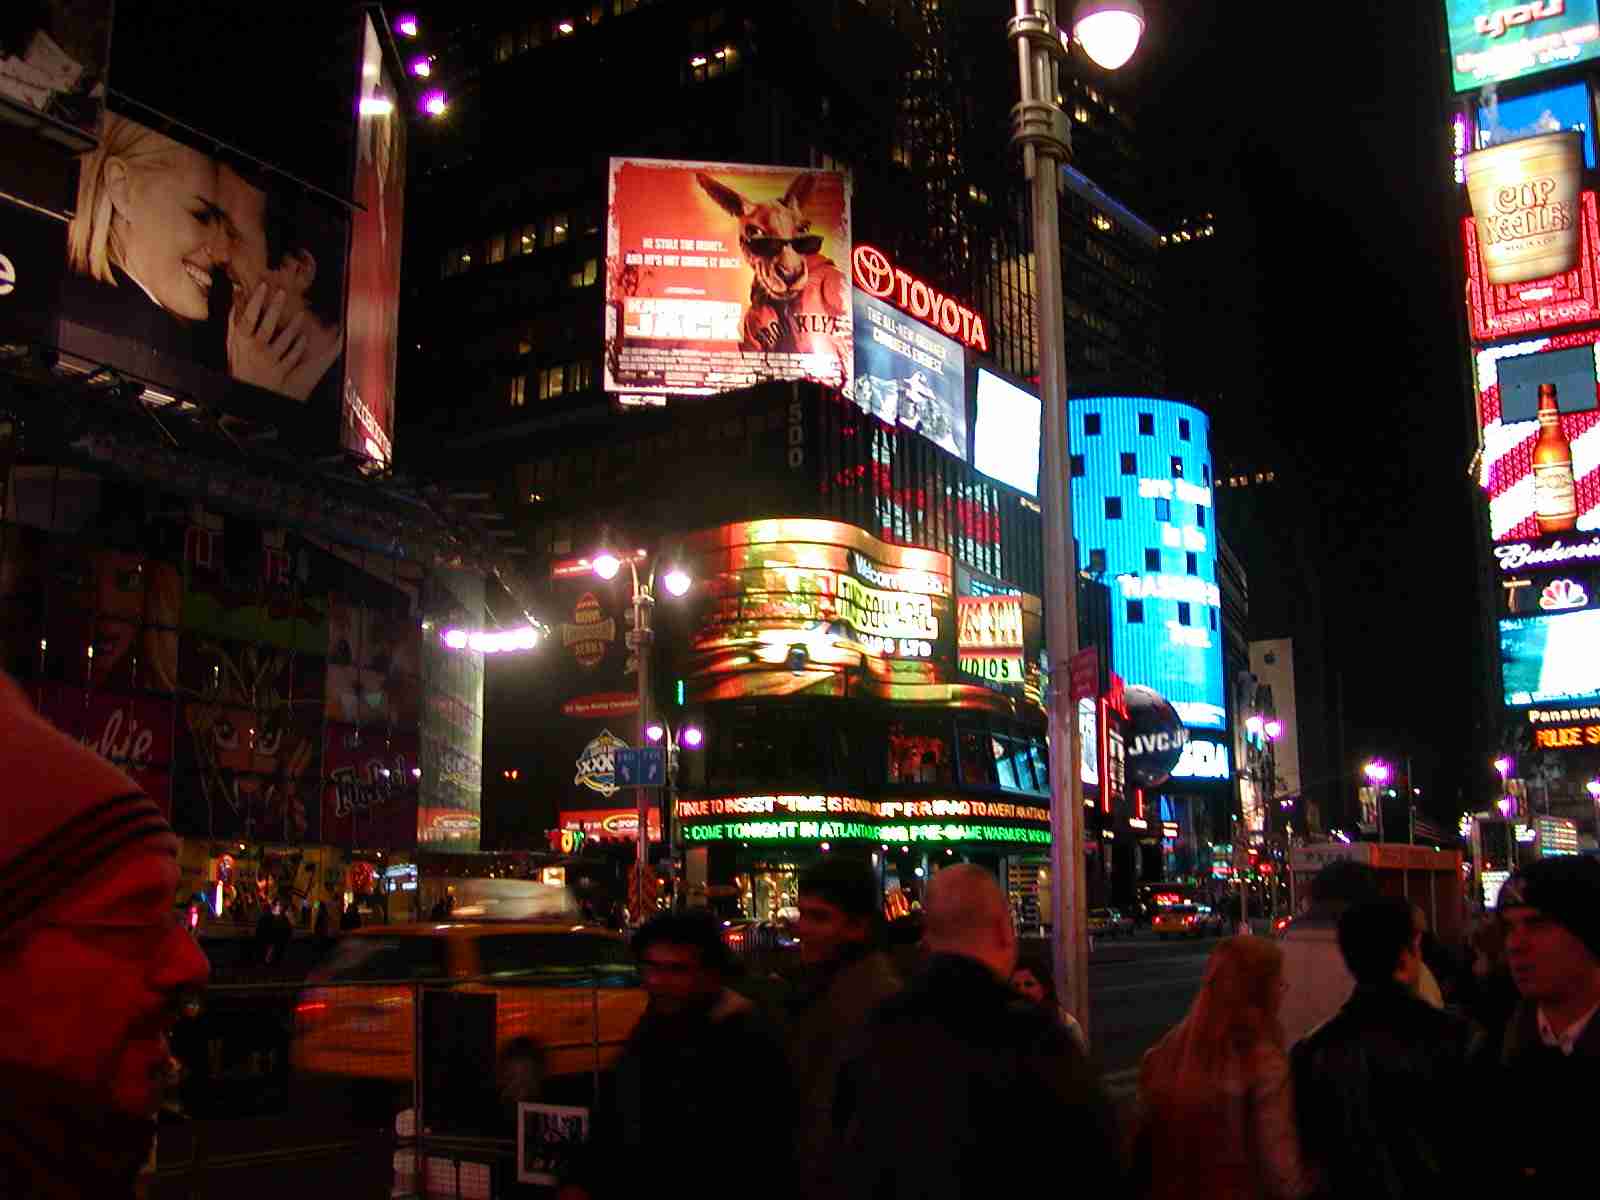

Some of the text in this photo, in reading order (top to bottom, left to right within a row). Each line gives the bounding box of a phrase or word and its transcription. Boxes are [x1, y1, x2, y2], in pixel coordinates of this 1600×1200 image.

[1474, 0, 1565, 38] you
[1495, 177, 1556, 214] CUP
[895, 268, 987, 351] TOYOTA
[1128, 732, 1169, 756] JVC
[711, 799, 723, 815] TO
[725, 795, 774, 813] INSIST
[827, 796, 842, 812] IS
[970, 800, 987, 816] TO
[691, 824, 723, 840] COME
[725, 821, 799, 840] TONIGHT
[799, 820, 819, 839] IN
